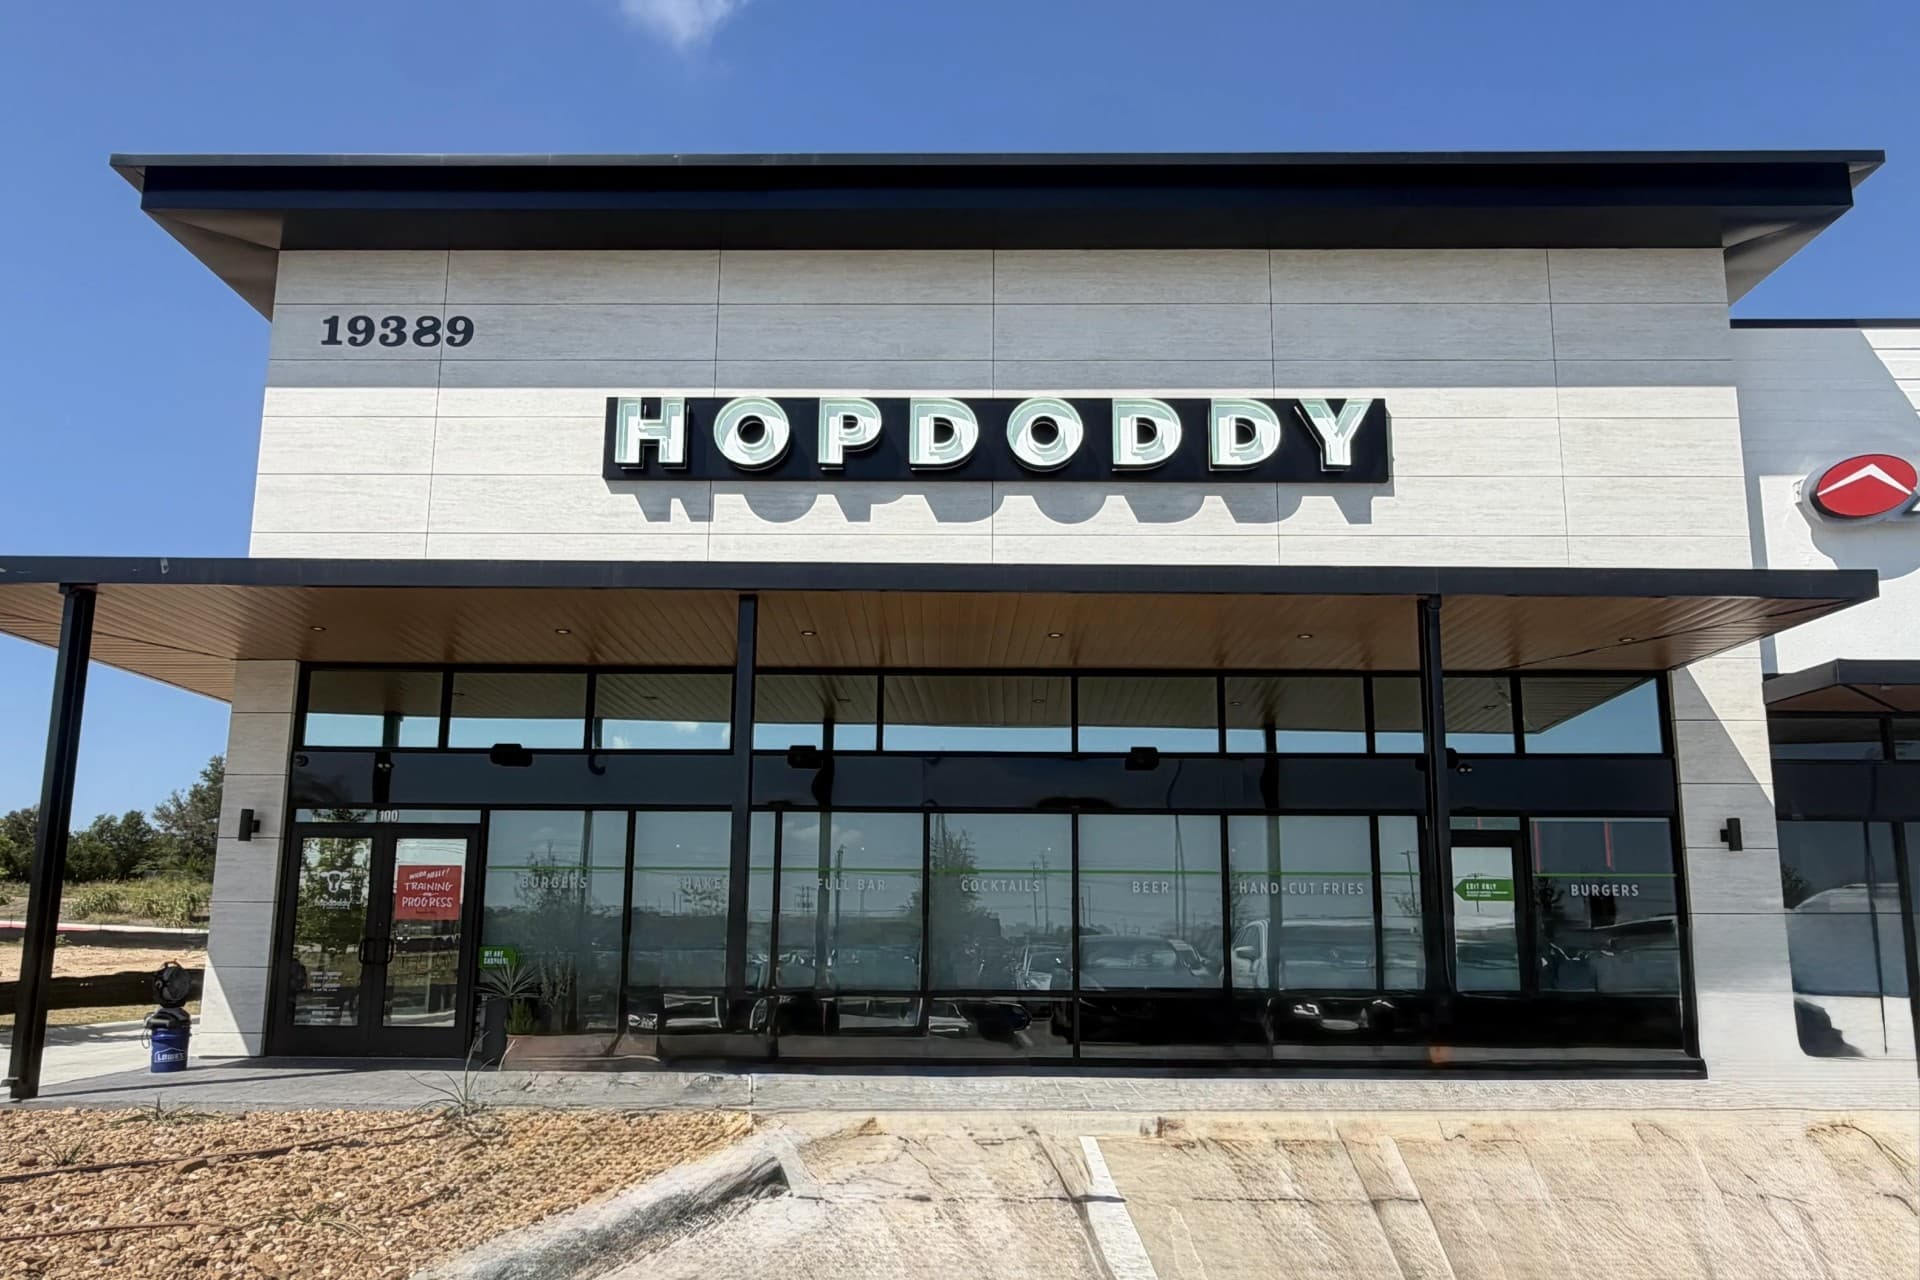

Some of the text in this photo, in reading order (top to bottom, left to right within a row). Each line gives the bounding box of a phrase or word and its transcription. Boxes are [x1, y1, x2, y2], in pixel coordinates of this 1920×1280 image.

[321, 315, 474, 347] 19389
[614, 396, 1374, 471] HOPDODDY
[379, 810, 398, 822] 100
[403, 882, 454, 892] TRAINING
[521, 877, 588, 889] BURGERS
[817, 878, 887, 891] FULL BAR
[961, 879, 1040, 892] COCKTAILS
[1132, 880, 1169, 893] BEER
[1239, 882, 1364, 895] HAND-CUT FRIES
[1570, 884, 1639, 897] BURGERS
[402, 896, 454, 908] PROGRESS
